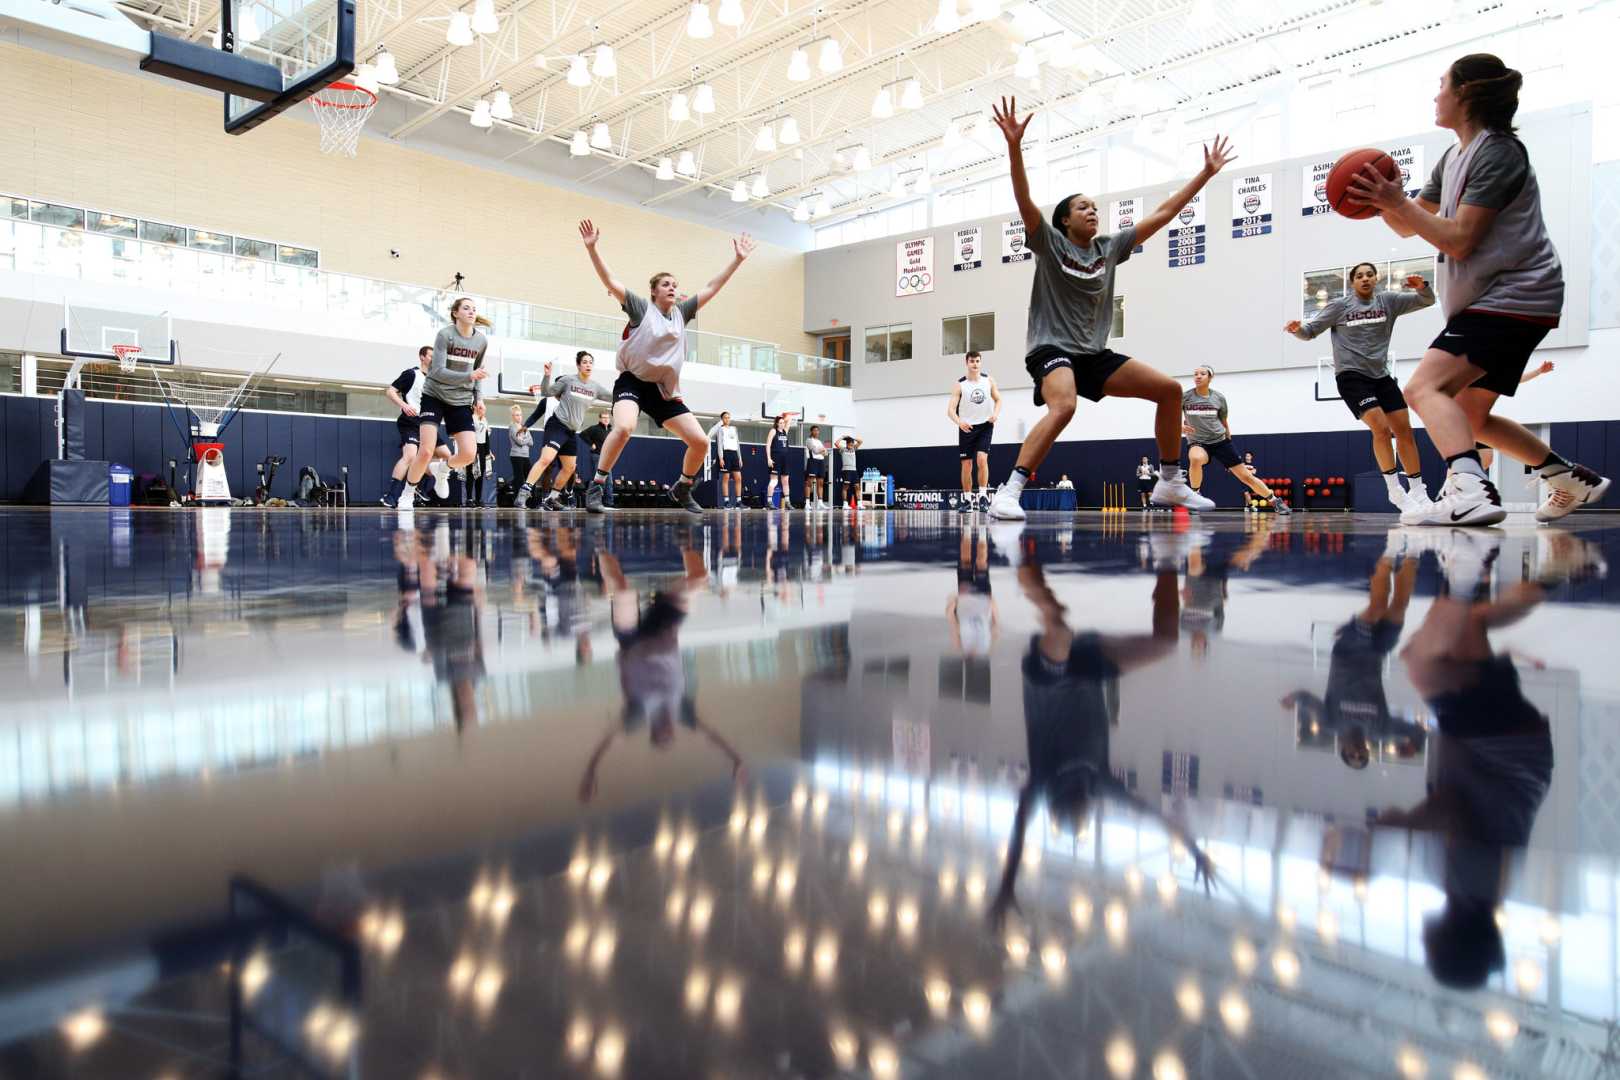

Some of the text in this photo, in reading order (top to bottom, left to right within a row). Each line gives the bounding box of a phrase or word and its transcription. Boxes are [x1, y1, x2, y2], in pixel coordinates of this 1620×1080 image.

[1390, 148, 1411, 158] MAYA
[1245, 176, 1260, 184] TINA
[1313, 172, 1329, 183] JON
[1238, 184, 1266, 195] CHARLES
[1119, 208, 1134, 216] CASH
[1242, 215, 1263, 225] 2012
[957, 228, 978, 238] REBECCA
[1005, 227, 1025, 236] WOLTER
[1178, 226, 1196, 236] 2004
[1242, 226, 1262, 236] 2016
[905, 240, 926, 249] OLYMPIC
[961, 236, 975, 244] LOBO
[1178, 237, 1196, 246] 2008
[907, 248, 923, 257] GAMES
[1178, 247, 1196, 256] 2012
[903, 265, 927, 274] Medalists
[1346, 310, 1387, 321] UCONN
[447, 344, 479, 359] UCONN
[571, 385, 594, 397] UCONN
[895, 492, 944, 503] NATIONAL
